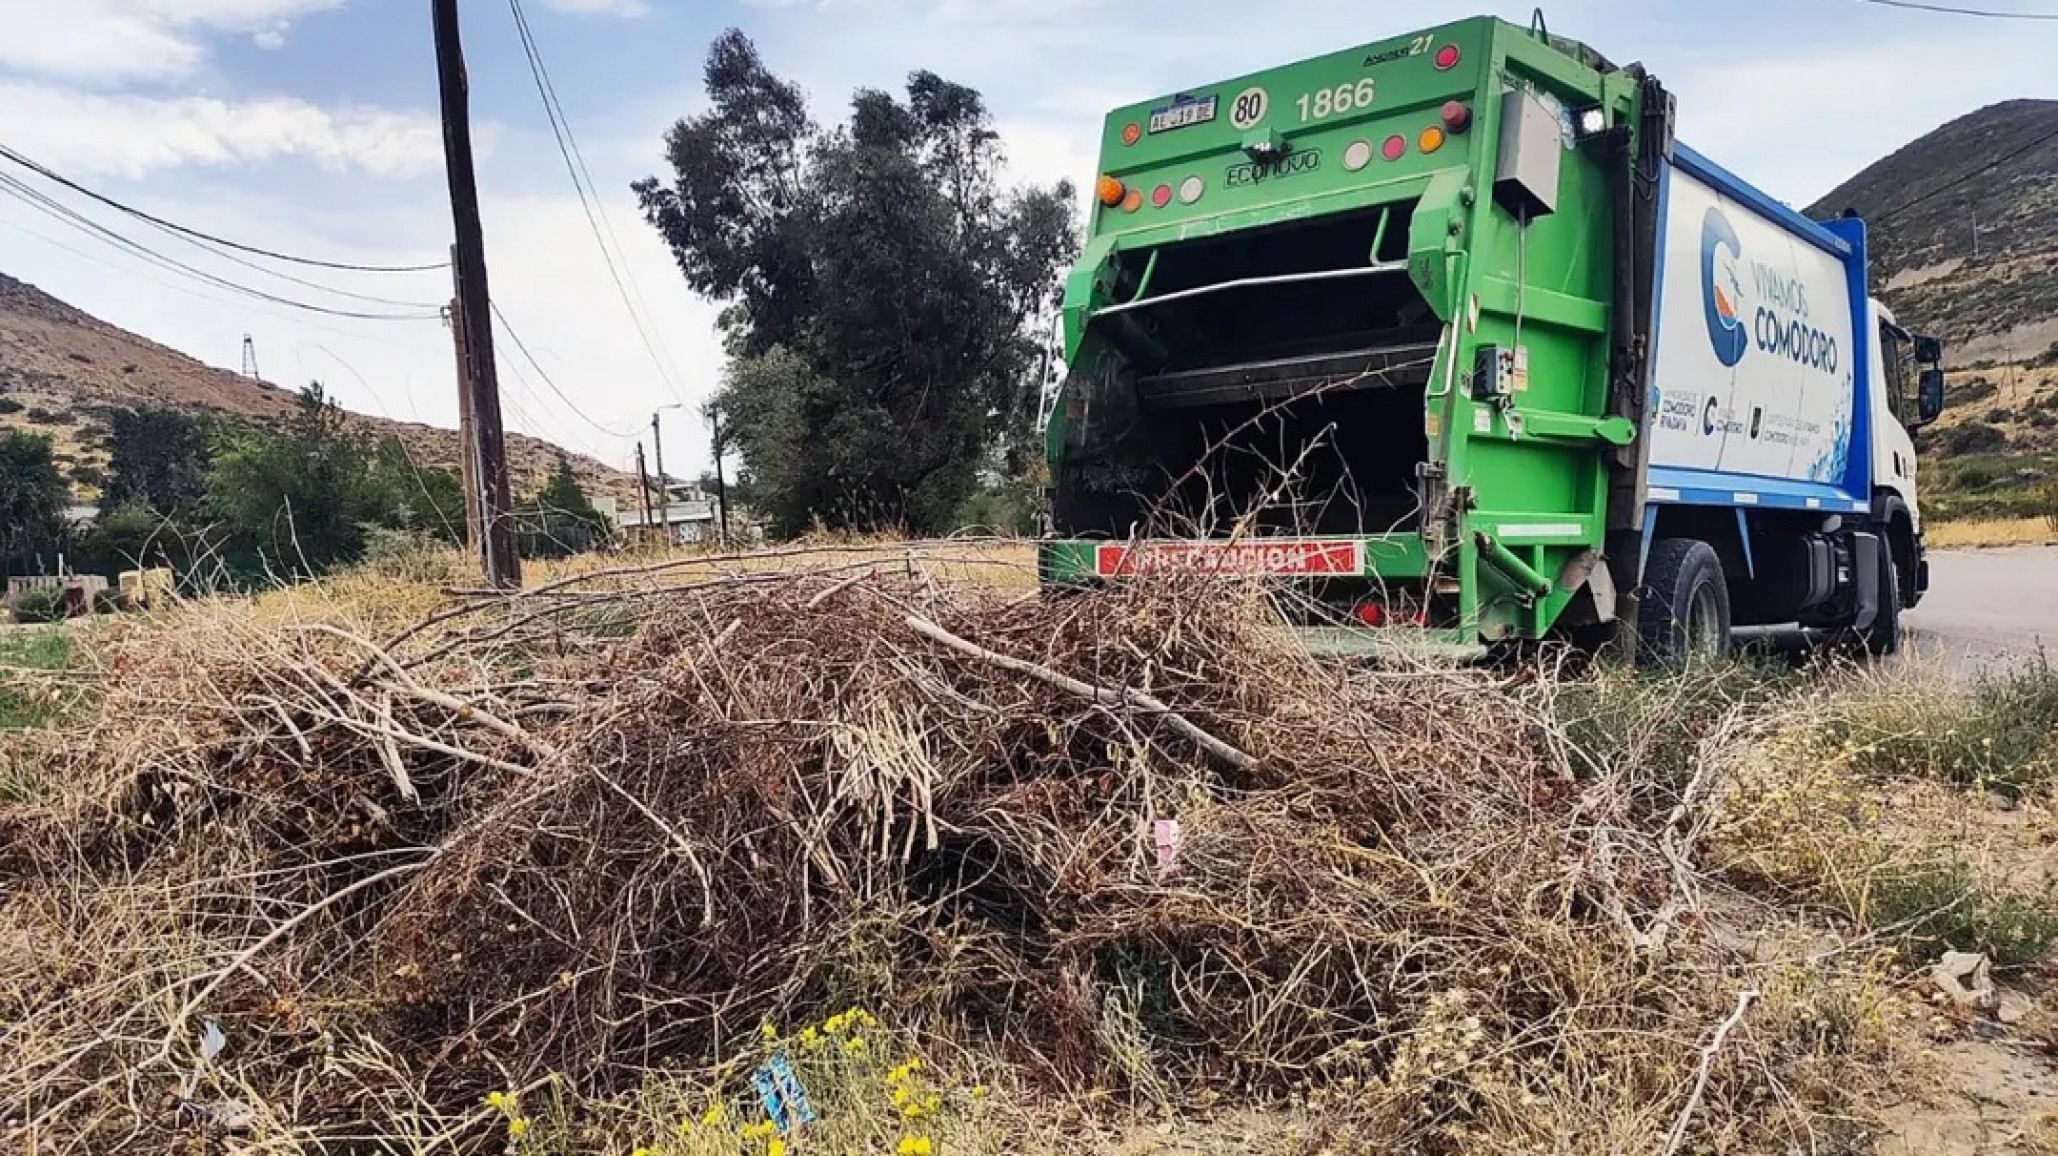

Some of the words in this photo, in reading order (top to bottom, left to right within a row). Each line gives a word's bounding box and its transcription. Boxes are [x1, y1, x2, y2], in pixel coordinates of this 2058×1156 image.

[1408, 33, 1434, 56] 21
[1235, 92, 1261, 123] 80
[1296, 77, 1375, 122] 1866
[1750, 257, 1809, 318] VIVAMOS
[1754, 304, 1838, 375] COMODORO
